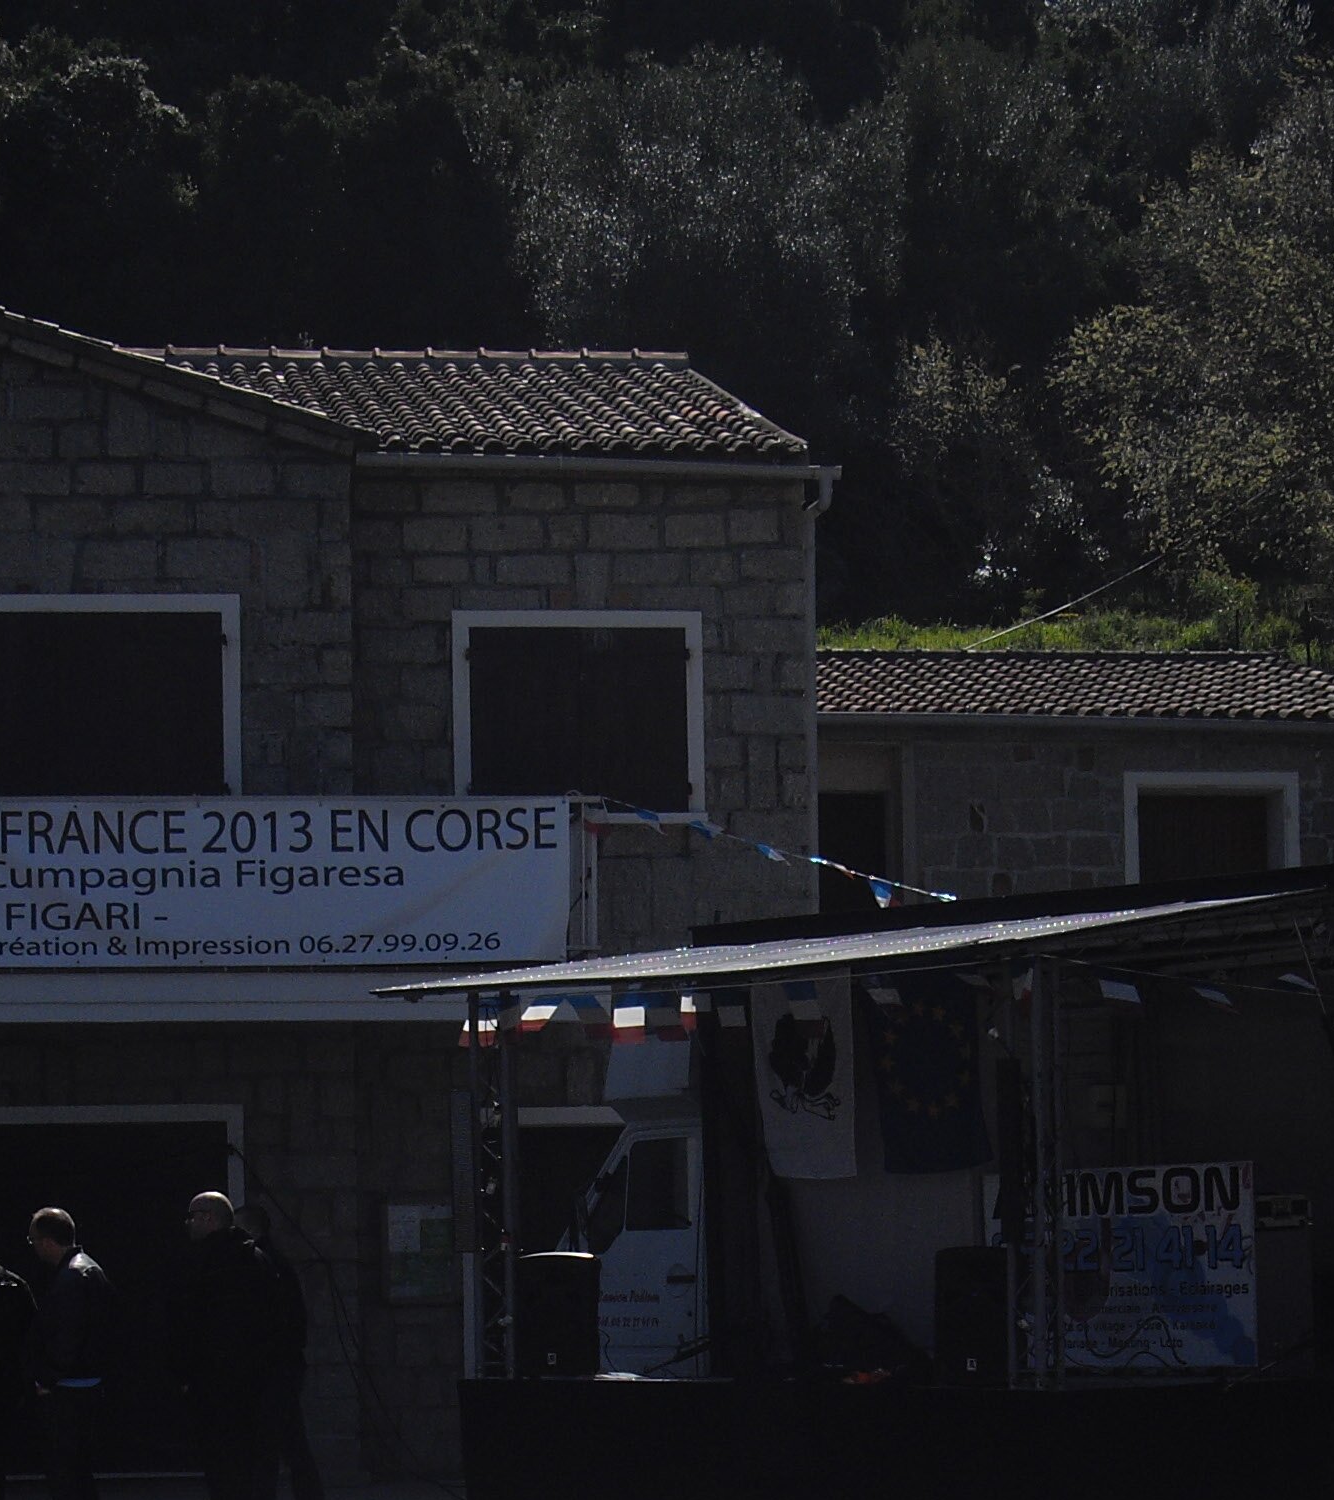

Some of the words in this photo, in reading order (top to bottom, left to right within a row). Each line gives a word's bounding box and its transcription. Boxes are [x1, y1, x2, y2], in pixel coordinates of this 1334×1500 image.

[1, 810, 187, 856] FRANCE
[202, 810, 313, 855] 2013
[331, 809, 389, 854] EN
[405, 807, 557, 852] CORSE
[236, 859, 405, 895] Figaresa
[6, 902, 141, 931] FIGARI
[107, 937, 127, 956] &
[136, 935, 291, 959] Impression
[300, 932, 501, 956] 06.27.99.09.26
[992, 1165, 1240, 1219] IMSON
[1112, 1226, 1147, 1272] 21
[1156, 1224, 1195, 1271] 41
[1205, 1222, 1245, 1270] 14
[1179, 1280, 1249, 1298] Eclairages
